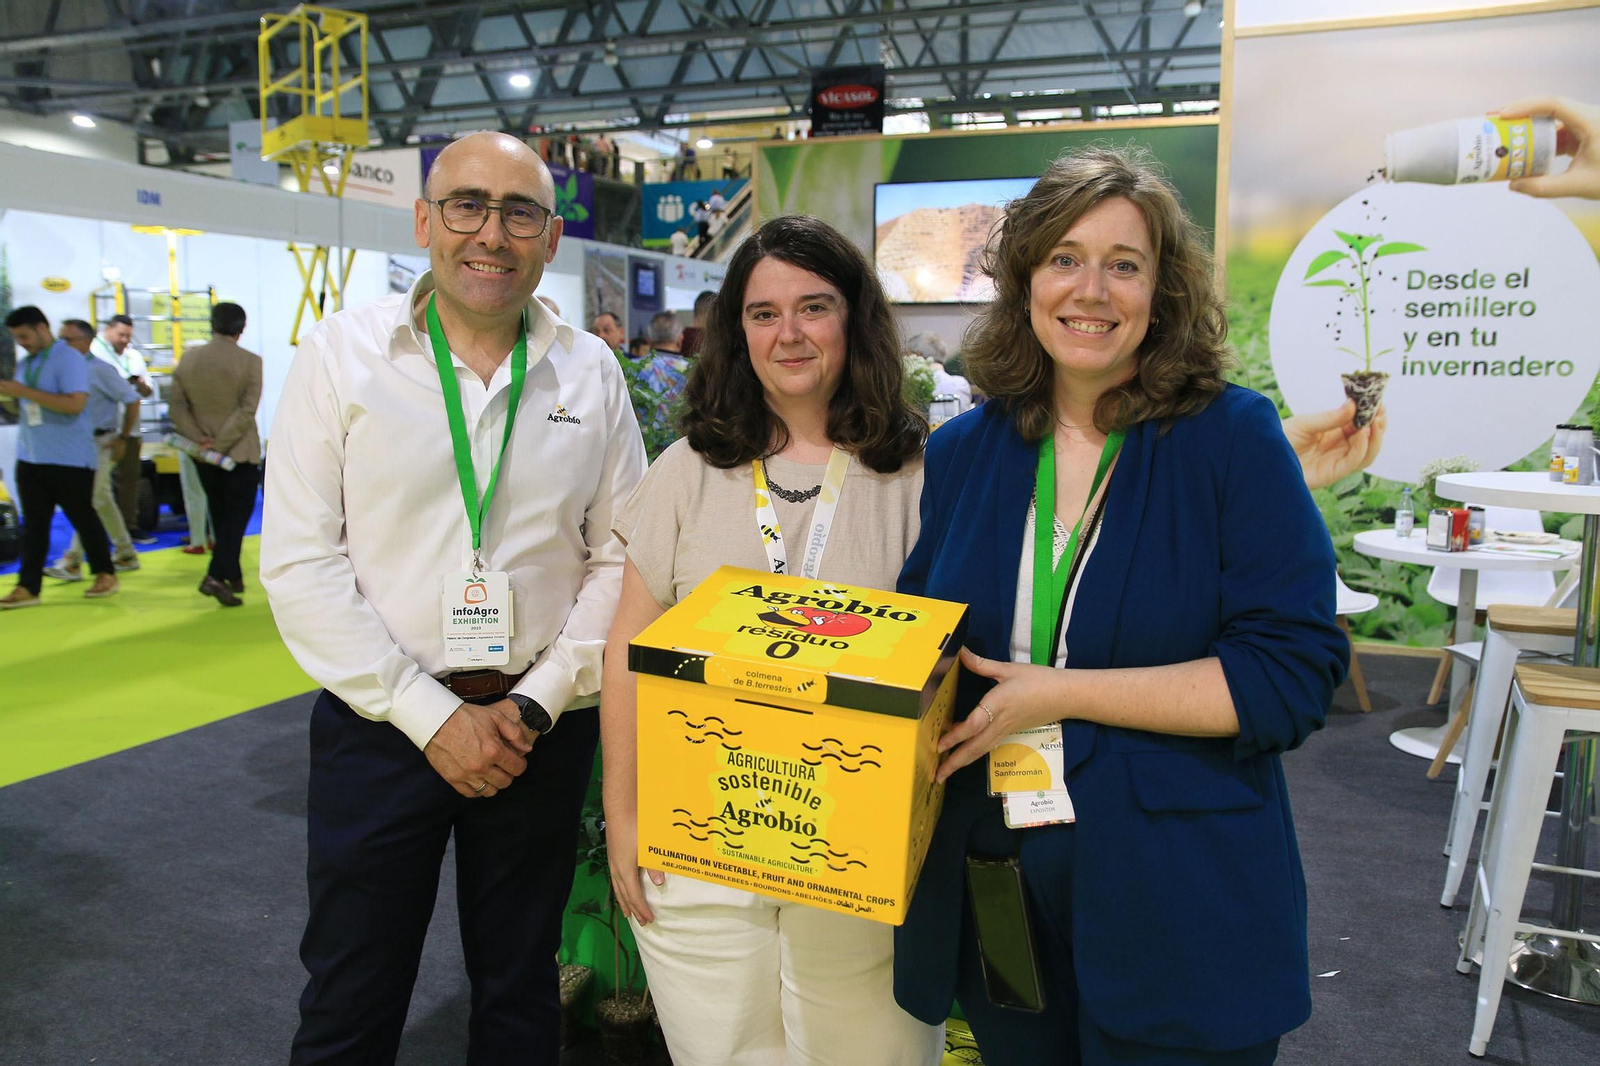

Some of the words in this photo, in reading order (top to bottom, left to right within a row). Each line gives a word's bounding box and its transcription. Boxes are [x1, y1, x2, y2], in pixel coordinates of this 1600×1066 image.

[342, 160, 394, 185] anco
[1406, 268, 1496, 290] Desde
[1505, 267, 1529, 289] el
[1404, 296, 1537, 318] semillero
[1403, 331, 1418, 352] y
[1427, 330, 1460, 347] en
[1470, 327, 1497, 347] tu
[1402, 355, 1574, 377] invernadero
[452, 607, 499, 617] infoAgro
[730, 584, 918, 622] Agrobío
[452, 617, 499, 625] EXHIBITION
[765, 640, 800, 660] 0
[733, 677, 745, 686] de
[745, 670, 783, 683] colmena
[727, 751, 816, 781] AGRICULTURA
[994, 760, 1017, 768] Isabel
[994, 769, 1043, 777] Santorromán
[717, 771, 822, 810] sostenible
[719, 801, 817, 837] Agrobío
[721, 848, 766, 864] SUSTAINABLE
[767, 859, 814, 875] AGRICULTURE
[648, 845, 698, 864] POLLINATION
[699, 857, 711, 867] ON
[712, 860, 760, 880] VEGETABLE,
[761, 872, 785, 884] FRUIT
[787, 878, 805, 888] AND
[807, 881, 864, 901] ORNAMENTAL
[866, 895, 896, 907] CROPS
